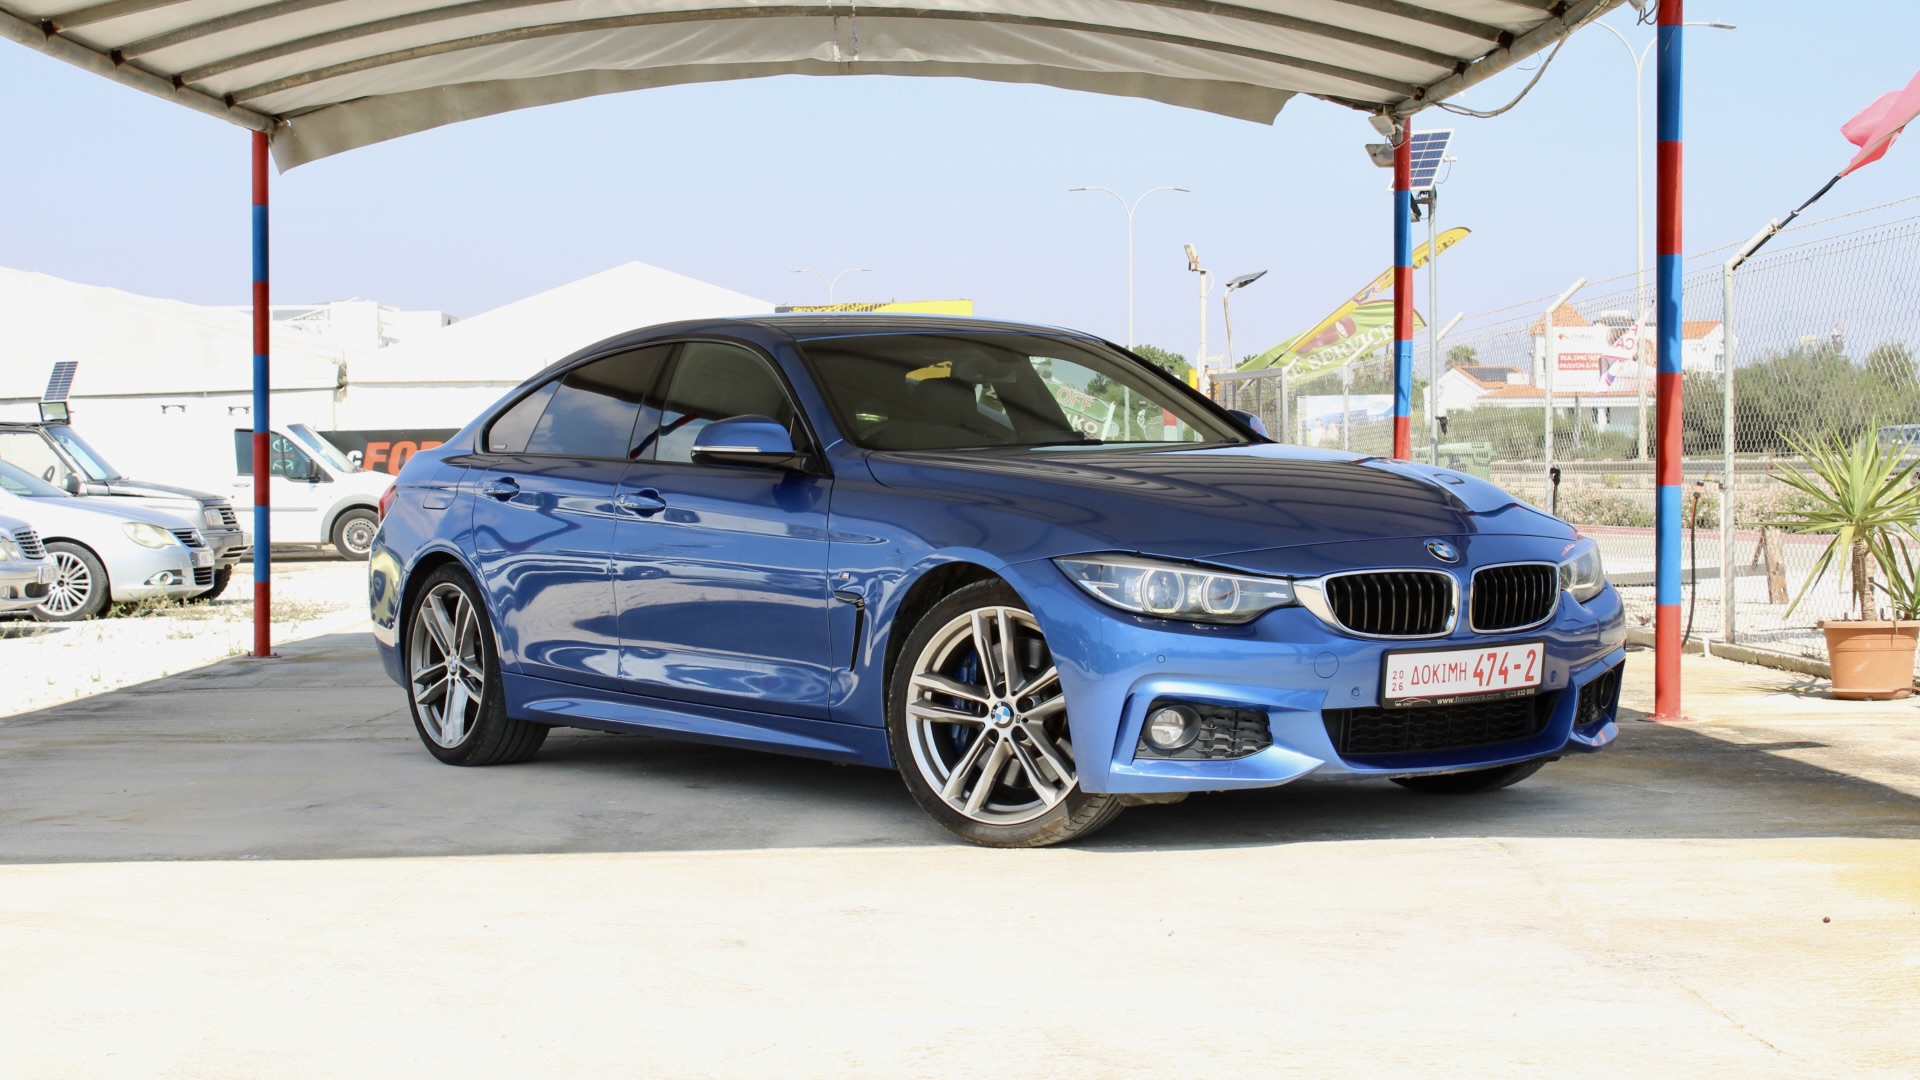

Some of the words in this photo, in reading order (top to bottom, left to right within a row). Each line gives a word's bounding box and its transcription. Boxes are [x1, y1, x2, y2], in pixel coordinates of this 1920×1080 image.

[1307, 321, 1394, 372] SERVICE
[1056, 387, 1094, 412] OFF
[1410, 661, 1468, 686] ΔΟΚΙΜΗ
[1472, 649, 1537, 687] 474-2
